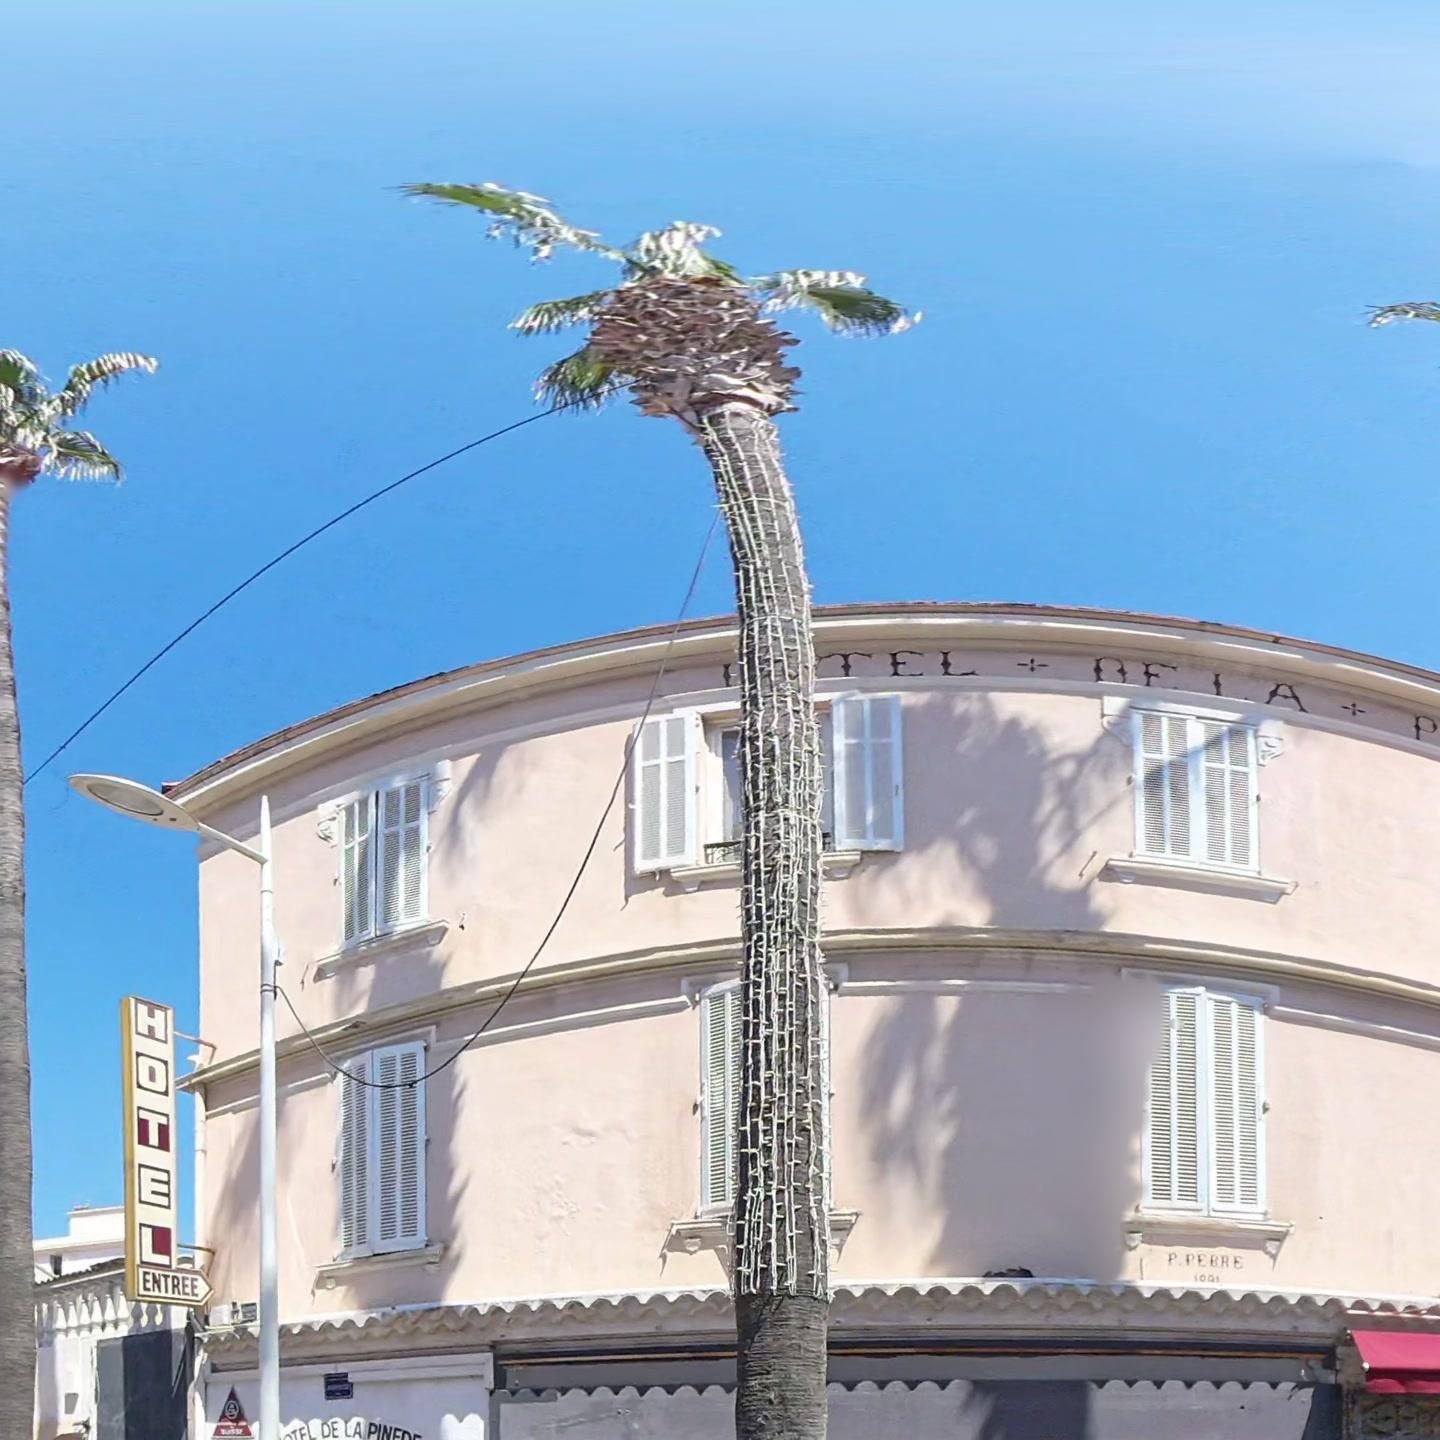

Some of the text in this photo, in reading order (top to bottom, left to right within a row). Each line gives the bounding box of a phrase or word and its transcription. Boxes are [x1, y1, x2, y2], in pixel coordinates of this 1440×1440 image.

[136, 1001, 172, 1268] HOTEL
[142, 1270, 199, 1298] ENTREE
[321, 1420, 340, 1439] DE
[344, 1420, 362, 1439] LA
